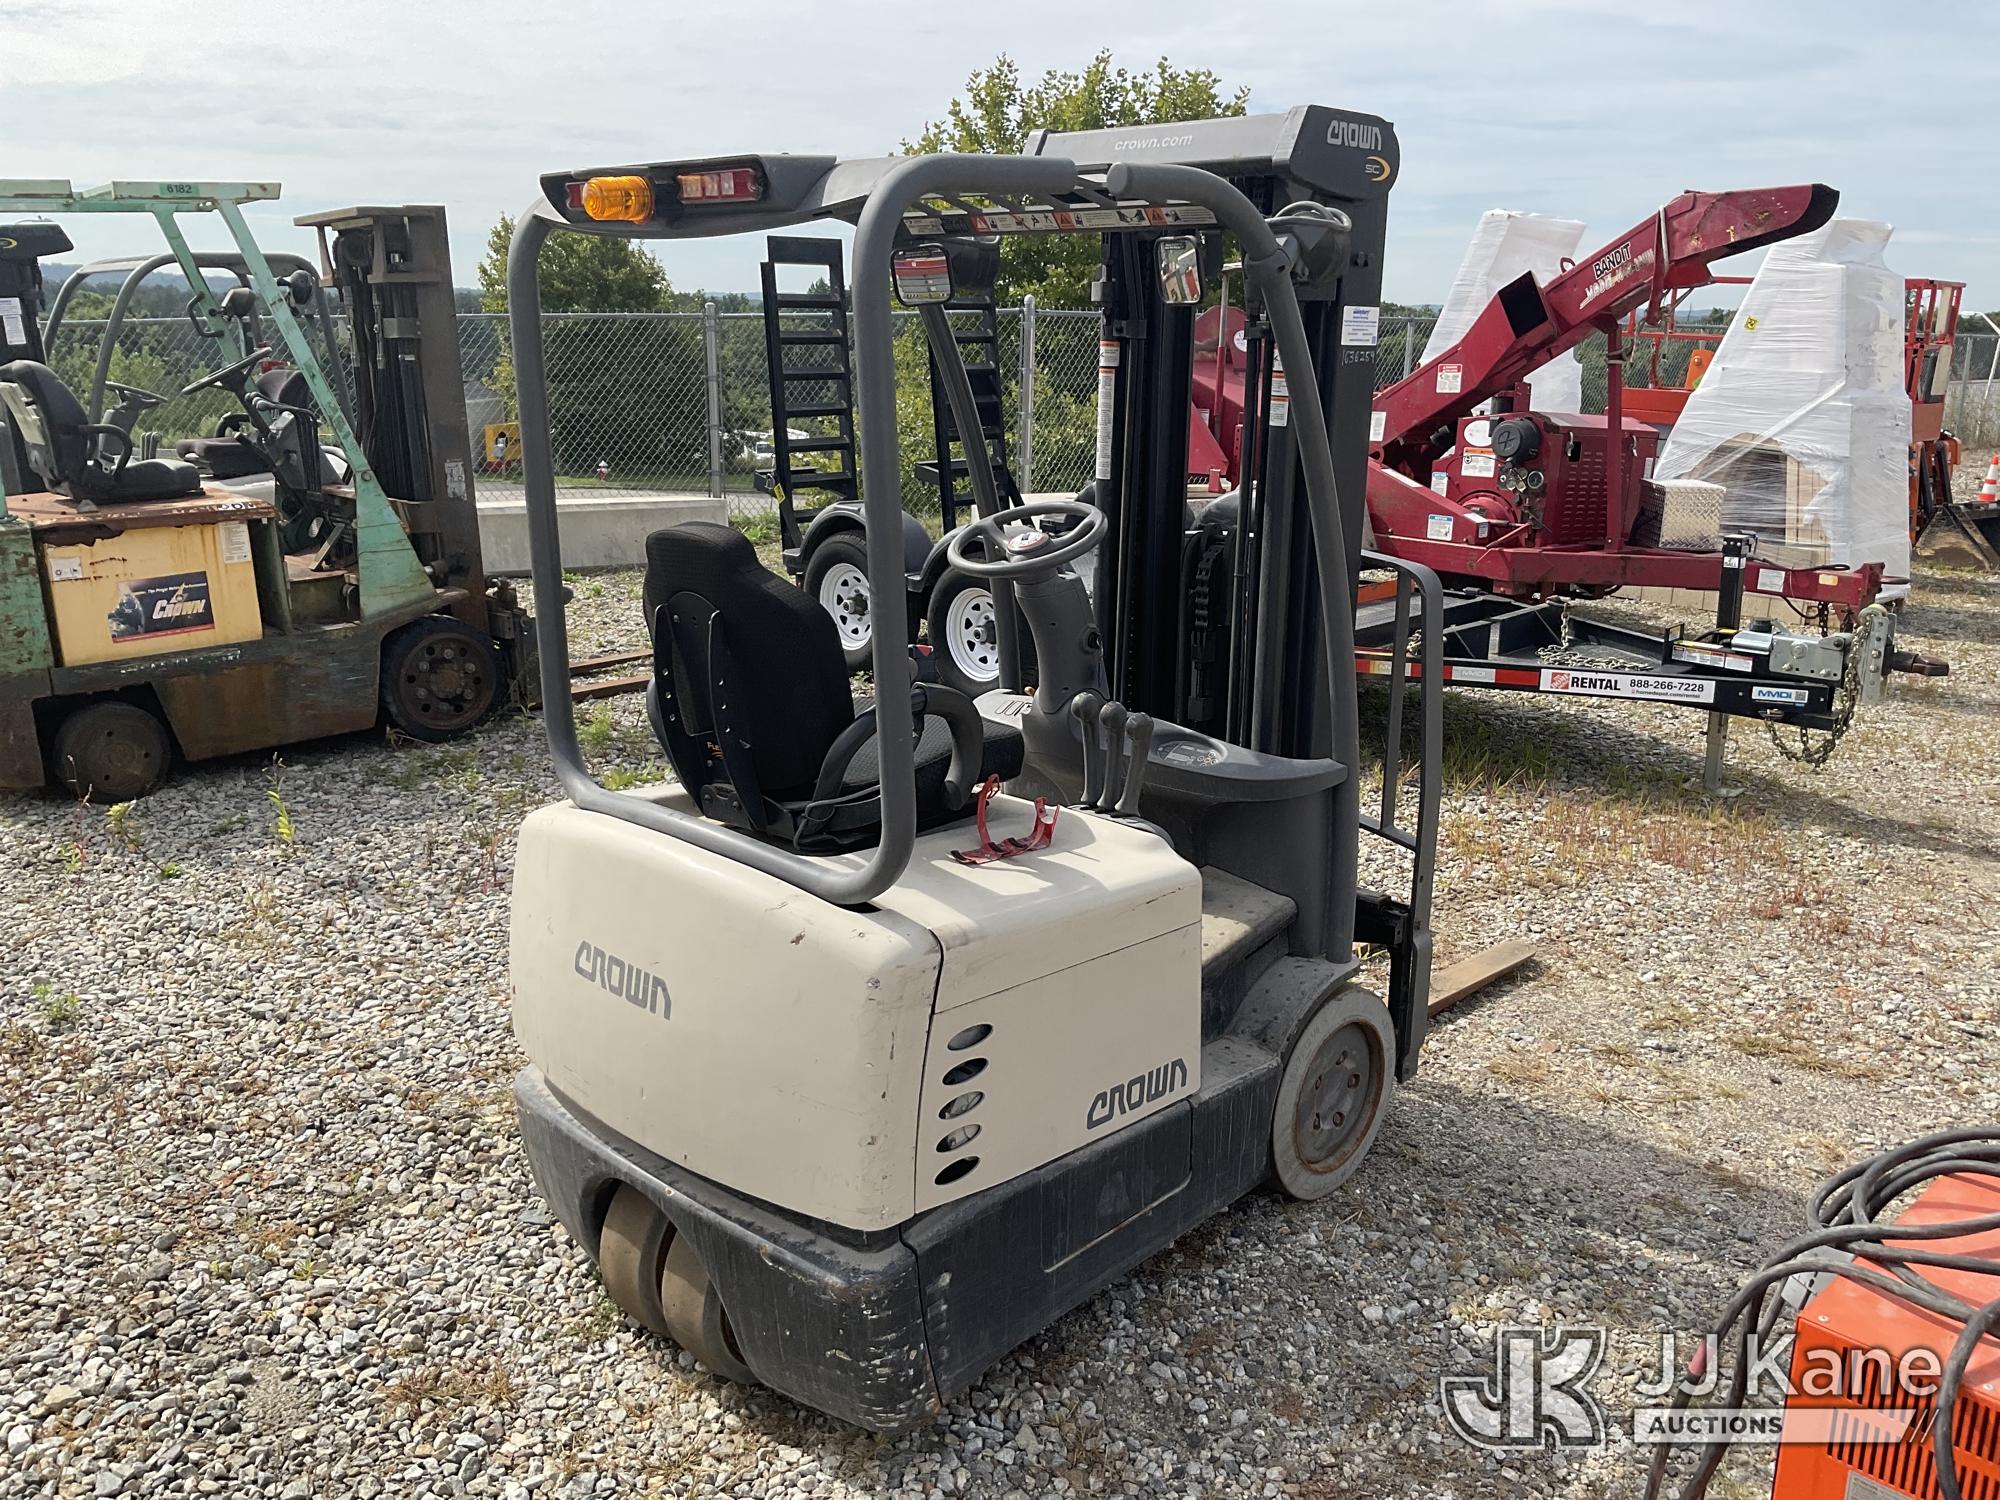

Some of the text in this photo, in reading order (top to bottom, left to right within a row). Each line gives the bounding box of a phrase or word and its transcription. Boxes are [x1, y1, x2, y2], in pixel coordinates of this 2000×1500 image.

[1114, 134, 1194, 151] crown.com
[1326, 119, 1382, 152] CROWN
[166, 183, 193, 194] 6182
[1592, 241, 1632, 280] BANDIT
[1571, 676, 1705, 693] RENTAL 888-266-7228
[575, 940, 672, 1021] CROWN
[1086, 1058, 1188, 1130] CROWN
